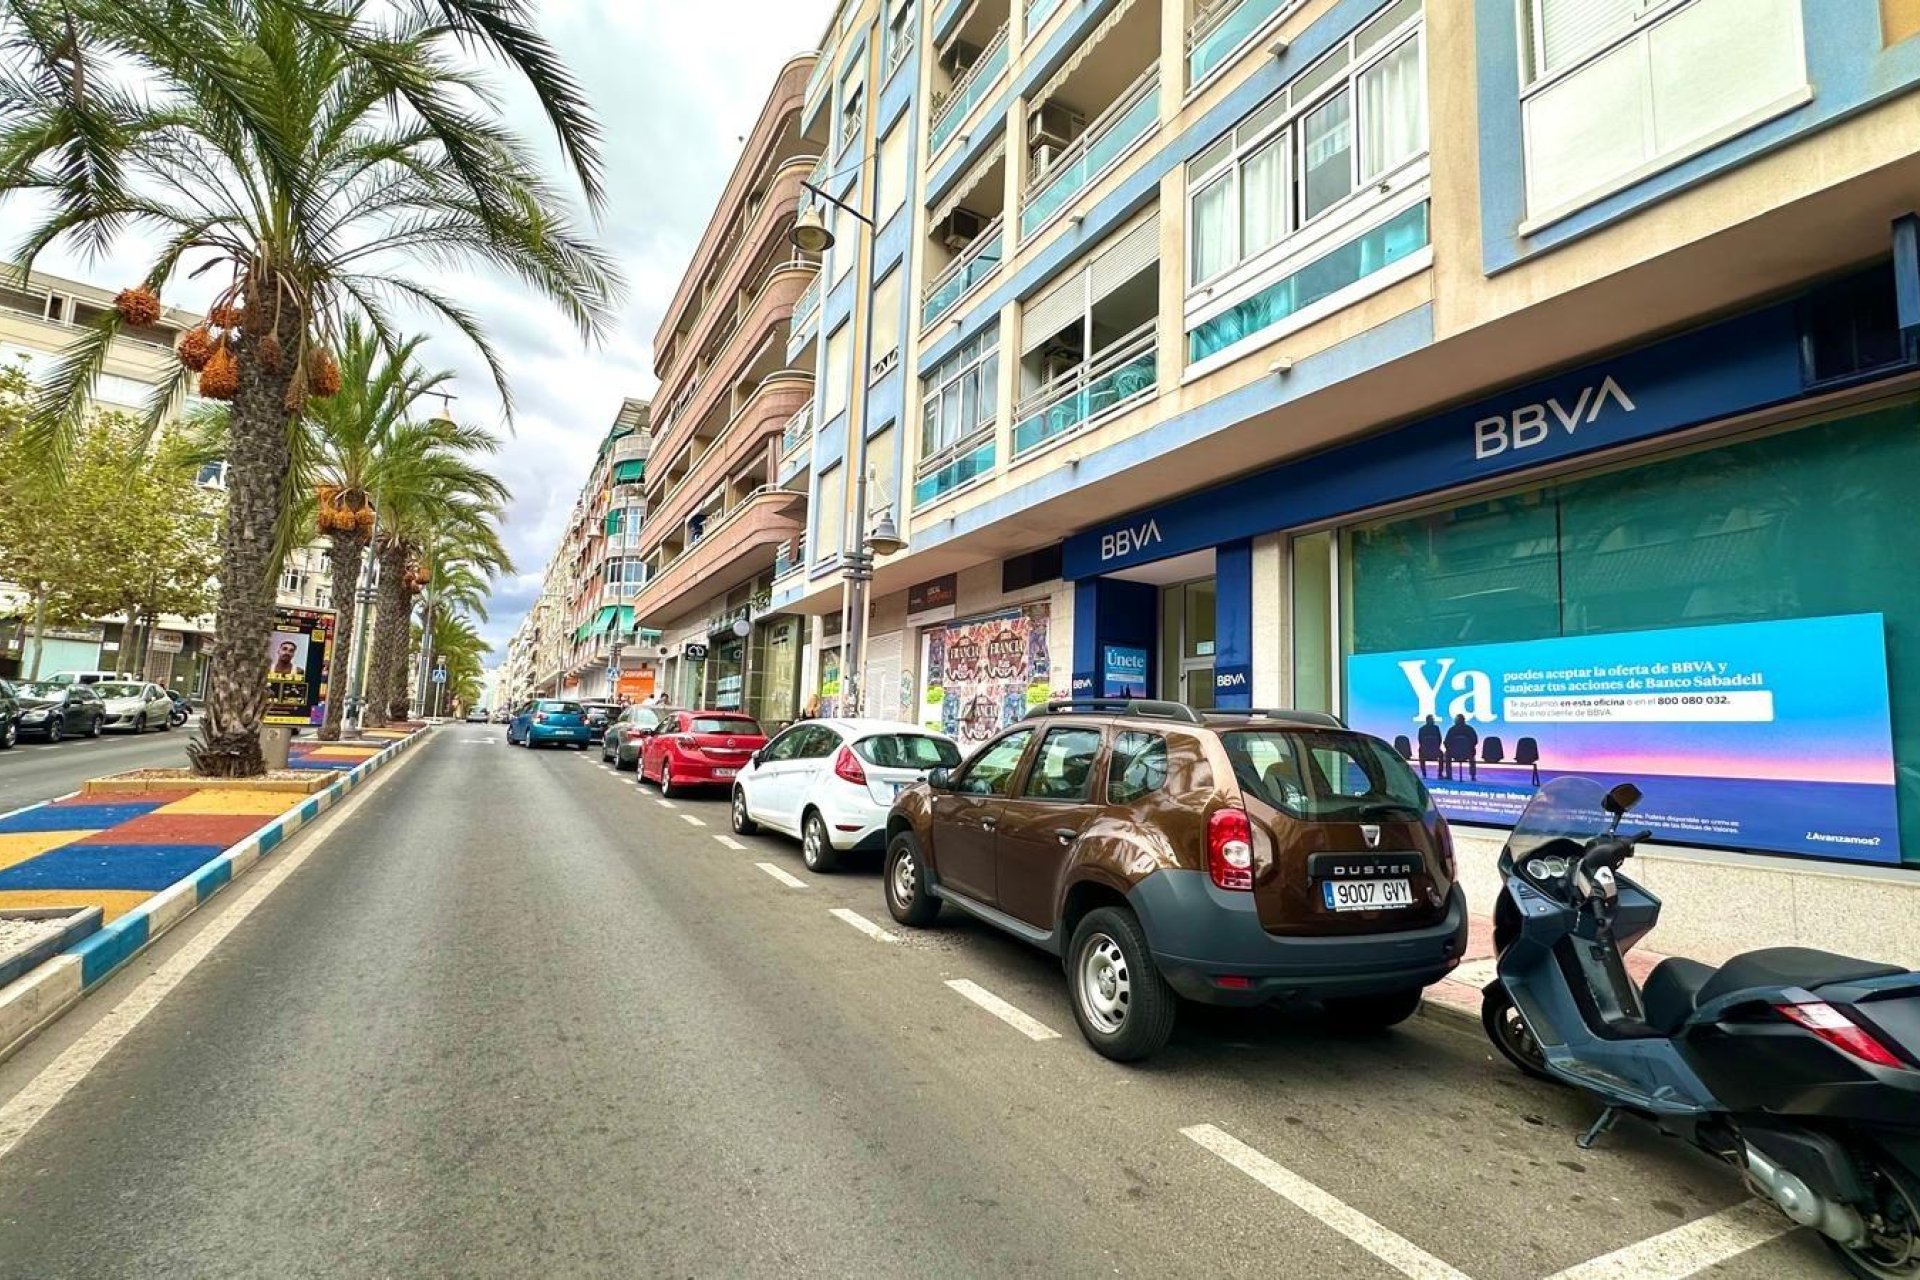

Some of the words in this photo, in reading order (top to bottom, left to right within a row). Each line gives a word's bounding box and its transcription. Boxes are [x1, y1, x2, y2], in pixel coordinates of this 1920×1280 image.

[1475, 376, 1636, 459] BBVA
[1102, 518, 1162, 560] BBVA
[1107, 649, 1144, 668] Únete
[1217, 673, 1246, 687] BBVA
[1503, 669, 1544, 682] puedes
[1545, 668, 1592, 680] aceptar
[1593, 666, 1606, 677] la
[1608, 665, 1649, 675] oferta
[1650, 662, 1669, 674] de
[1671, 661, 1715, 673] BBVA
[1717, 661, 1728, 674] y
[1398, 658, 1498, 723] Ya
[1503, 683, 1545, 694] canjear
[1547, 682, 1567, 692] tus
[1568, 679, 1623, 691] acciones
[1626, 678, 1643, 689] de
[1646, 677, 1692, 688] Banco
[1694, 672, 1763, 688] Sabadell
[1572, 699, 1592, 707] esta
[1593, 697, 1625, 707] oficina
[1657, 696, 1679, 705] 800
[1681, 696, 1703, 705] 080
[1805, 831, 1881, 845] ¿Avanzamos?
[1334, 864, 1411, 876] DUSTER
[1338, 883, 1375, 904] 9007
[1383, 881, 1407, 902] GVY
